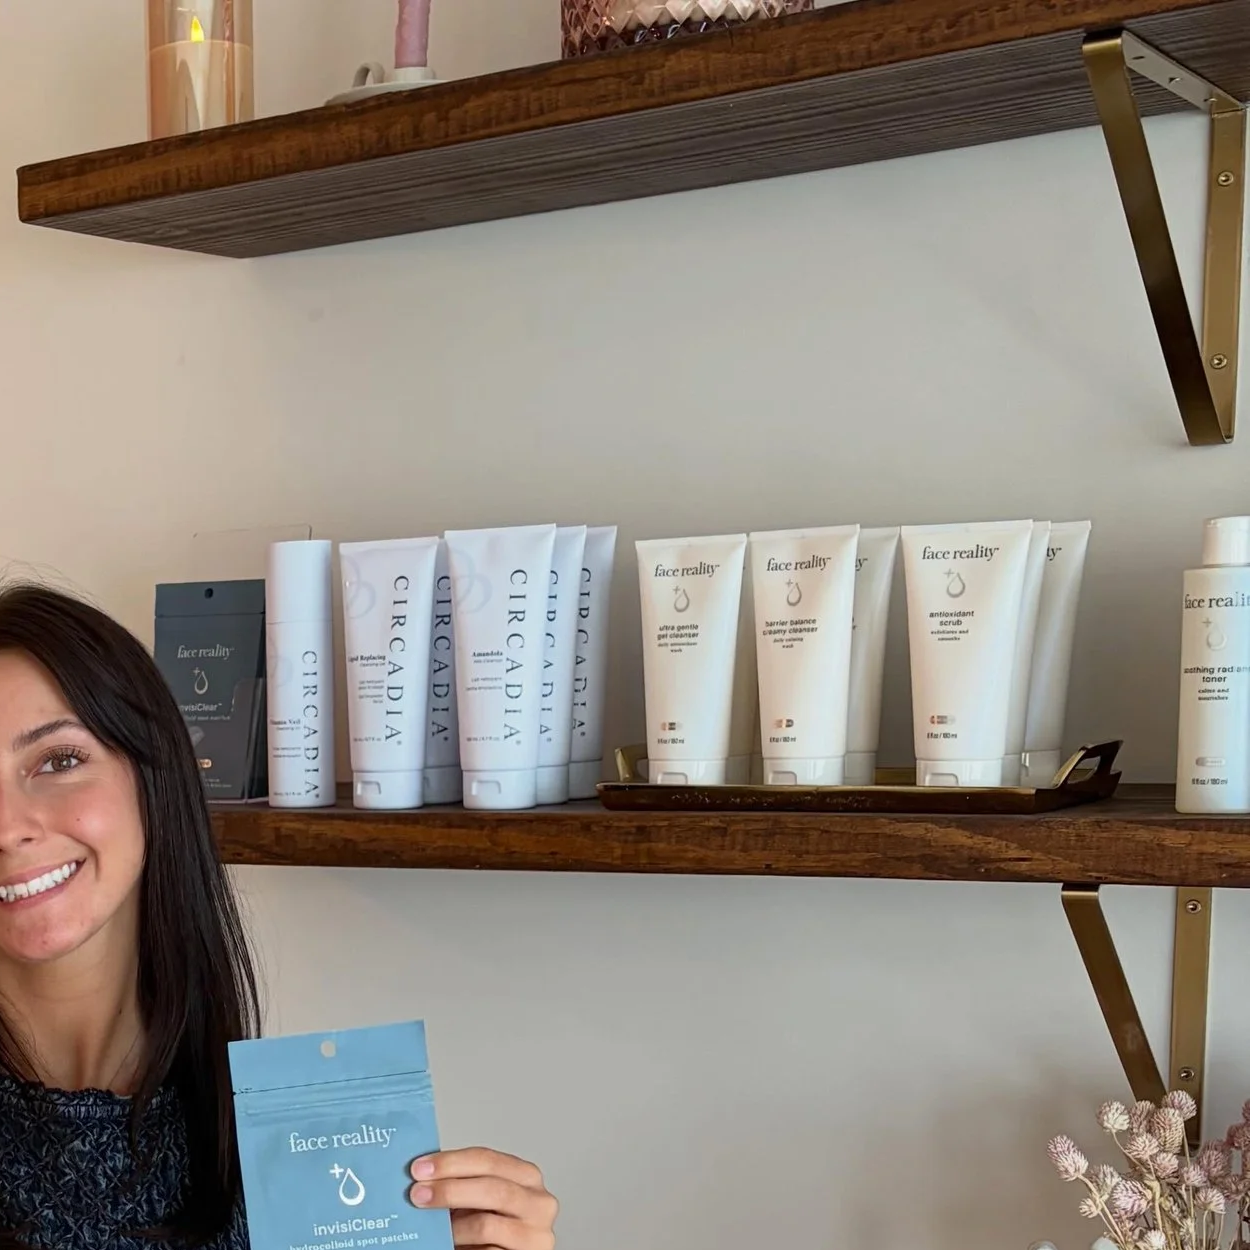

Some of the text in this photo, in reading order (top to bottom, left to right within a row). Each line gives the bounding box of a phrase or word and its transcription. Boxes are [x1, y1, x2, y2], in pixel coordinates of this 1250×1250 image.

[922, 546, 950, 560] face
[654, 564, 679, 577] face
[767, 558, 792, 571] face
[929, 610, 974, 618] antioxidant
[677, 624, 699, 632] gentle
[765, 618, 816, 627] barrier balance
[788, 626, 818, 634] cleanser
[177, 644, 198, 659] face
[360, 654, 386, 662] Replacing
[289, 1132, 328, 1152] face
[357, 1236, 378, 1248] spot
[381, 1231, 419, 1245] patches
